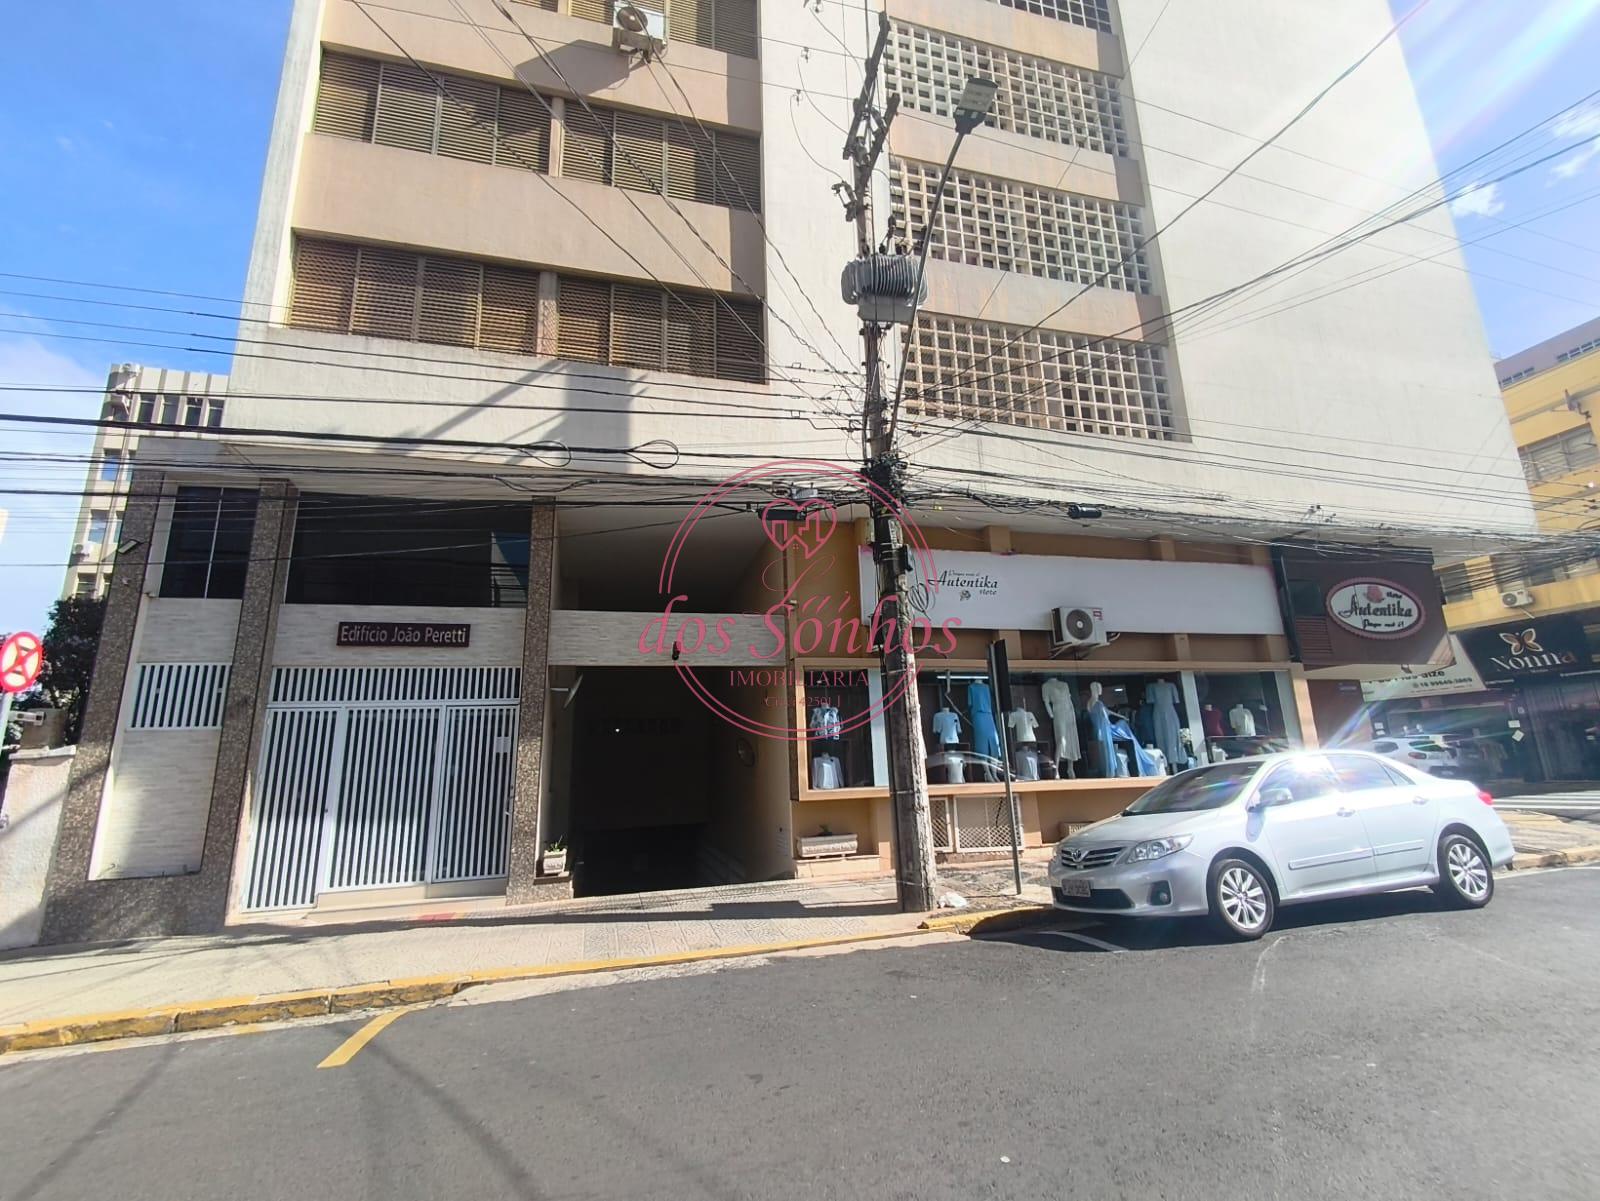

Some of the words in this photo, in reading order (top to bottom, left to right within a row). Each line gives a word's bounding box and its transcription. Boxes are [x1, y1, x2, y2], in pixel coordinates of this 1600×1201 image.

[928, 570, 998, 589] Autentika
[1338, 593, 1413, 619] Autentika
[391, 626, 420, 642] João
[424, 627, 466, 643] Peretti
